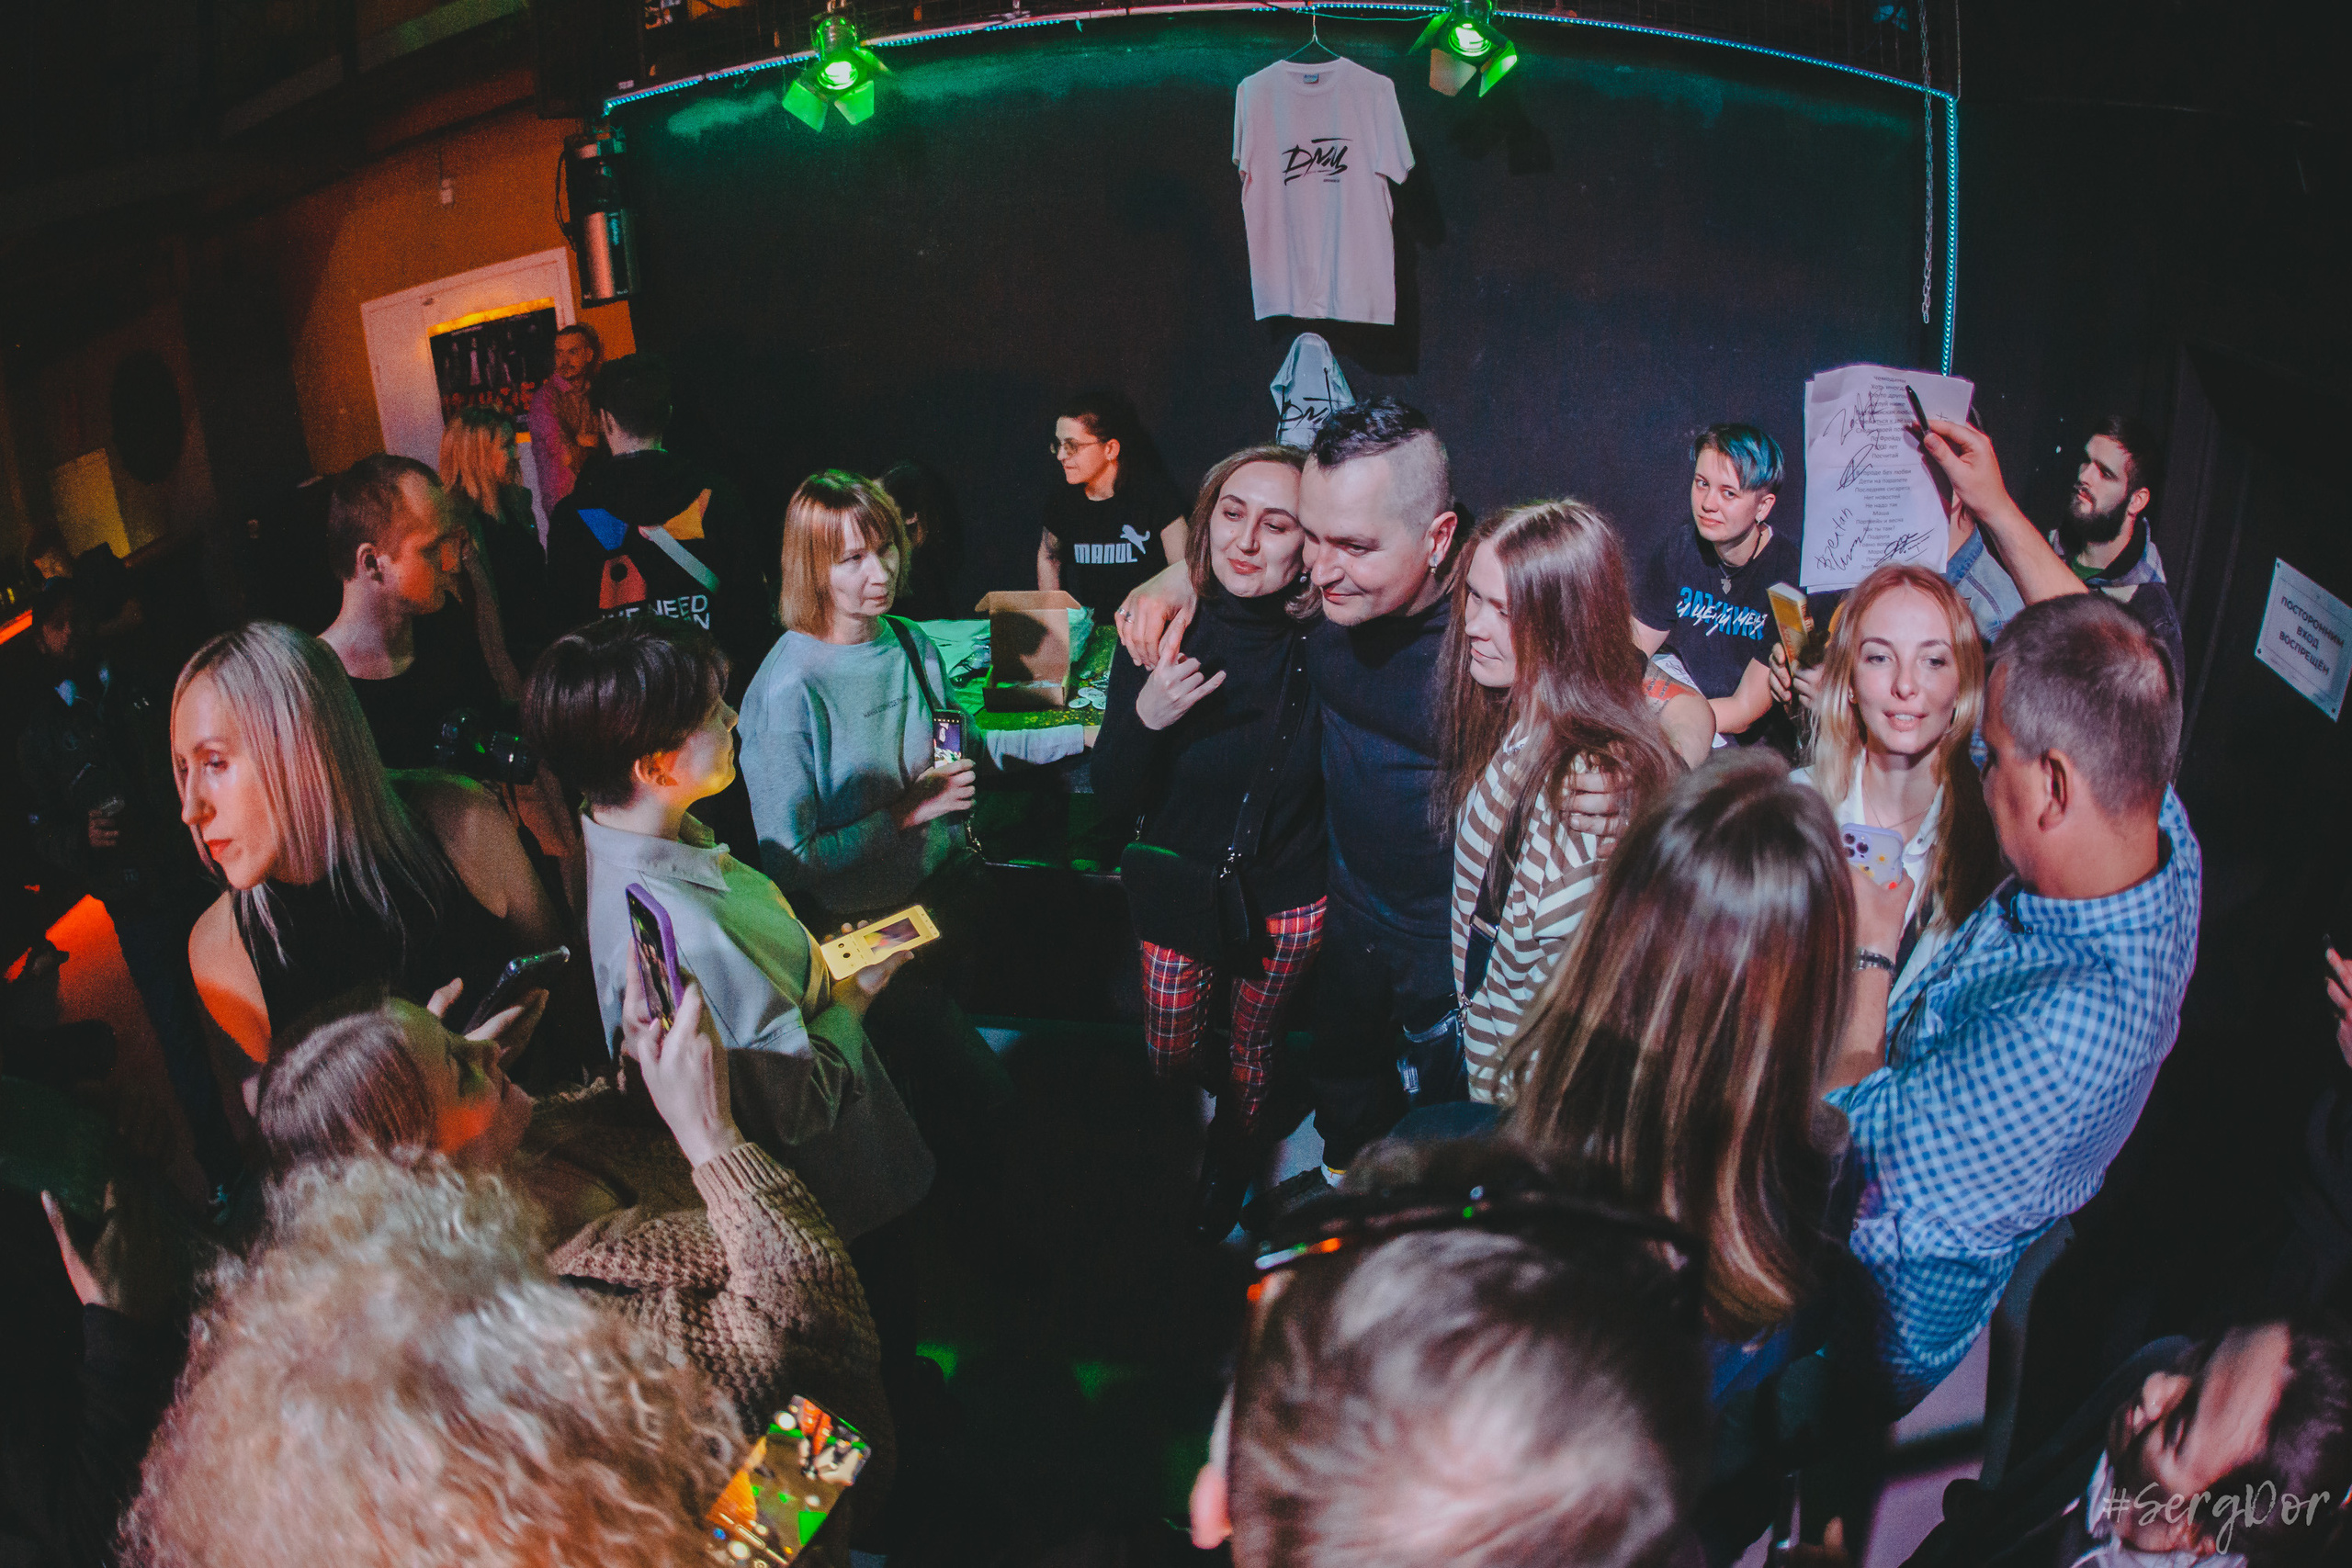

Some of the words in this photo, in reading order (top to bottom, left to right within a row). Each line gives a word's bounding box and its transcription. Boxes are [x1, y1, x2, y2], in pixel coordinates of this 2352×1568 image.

[1074, 543, 1138, 564] MANUL
[2280, 595, 2345, 649] ПОСТОРОННИМ
[2296, 626, 2320, 651] ВХОД
[2278, 630, 2330, 676] ВОСПРЕЩЁН
